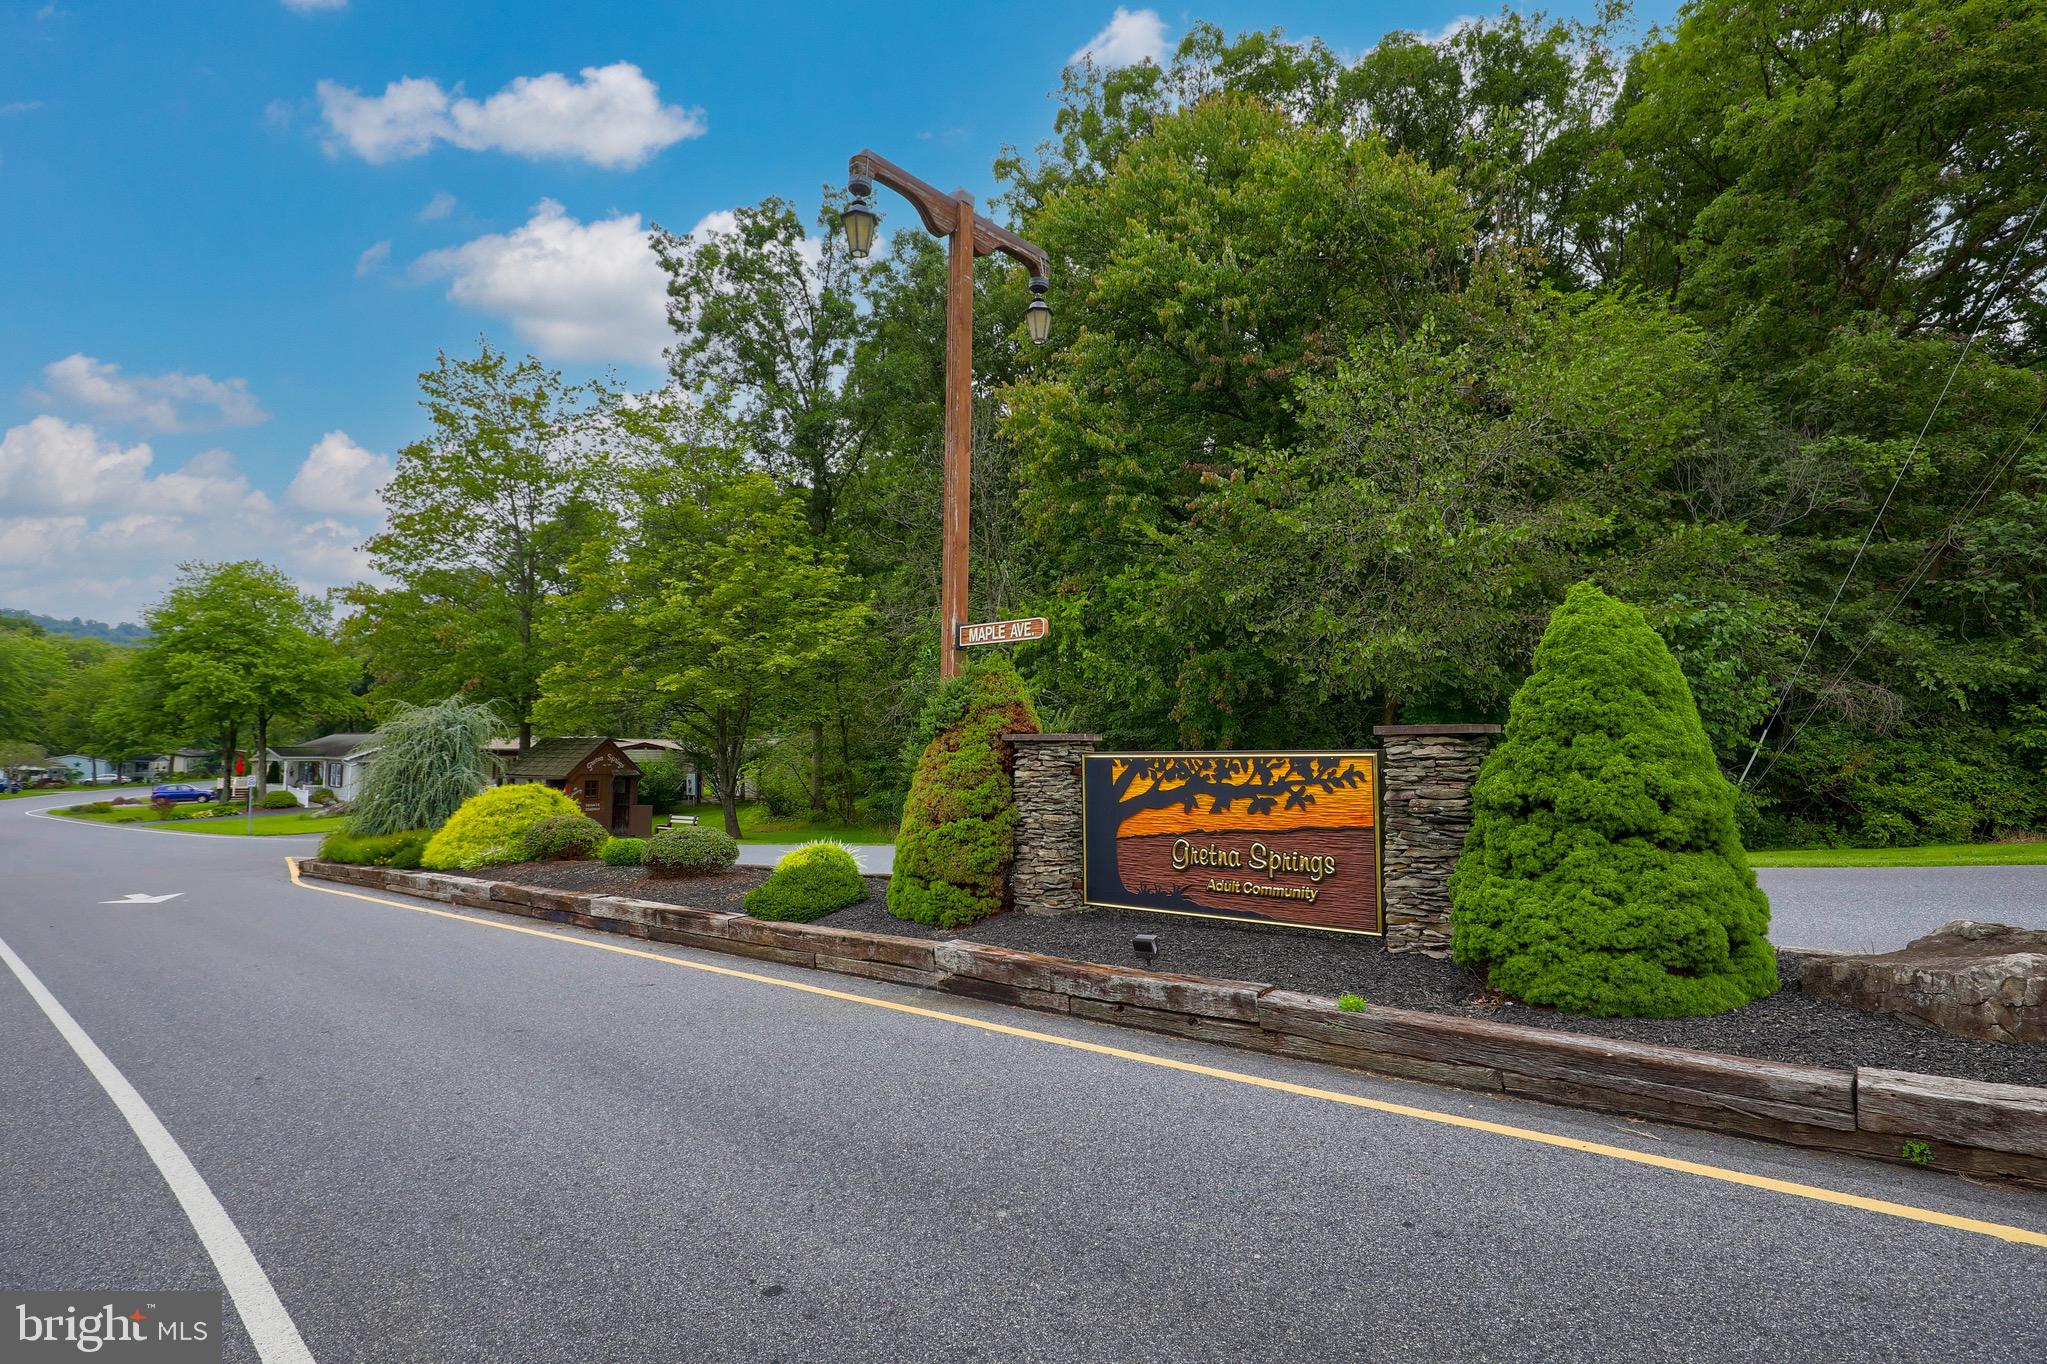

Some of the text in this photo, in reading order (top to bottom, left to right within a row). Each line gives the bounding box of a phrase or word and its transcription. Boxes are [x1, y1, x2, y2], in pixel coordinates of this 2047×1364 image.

[969, 622, 1035, 642] MAPLE AVE.
[1172, 838, 1336, 882] Gretna Springs
[1206, 879, 1319, 902] Adult Community
